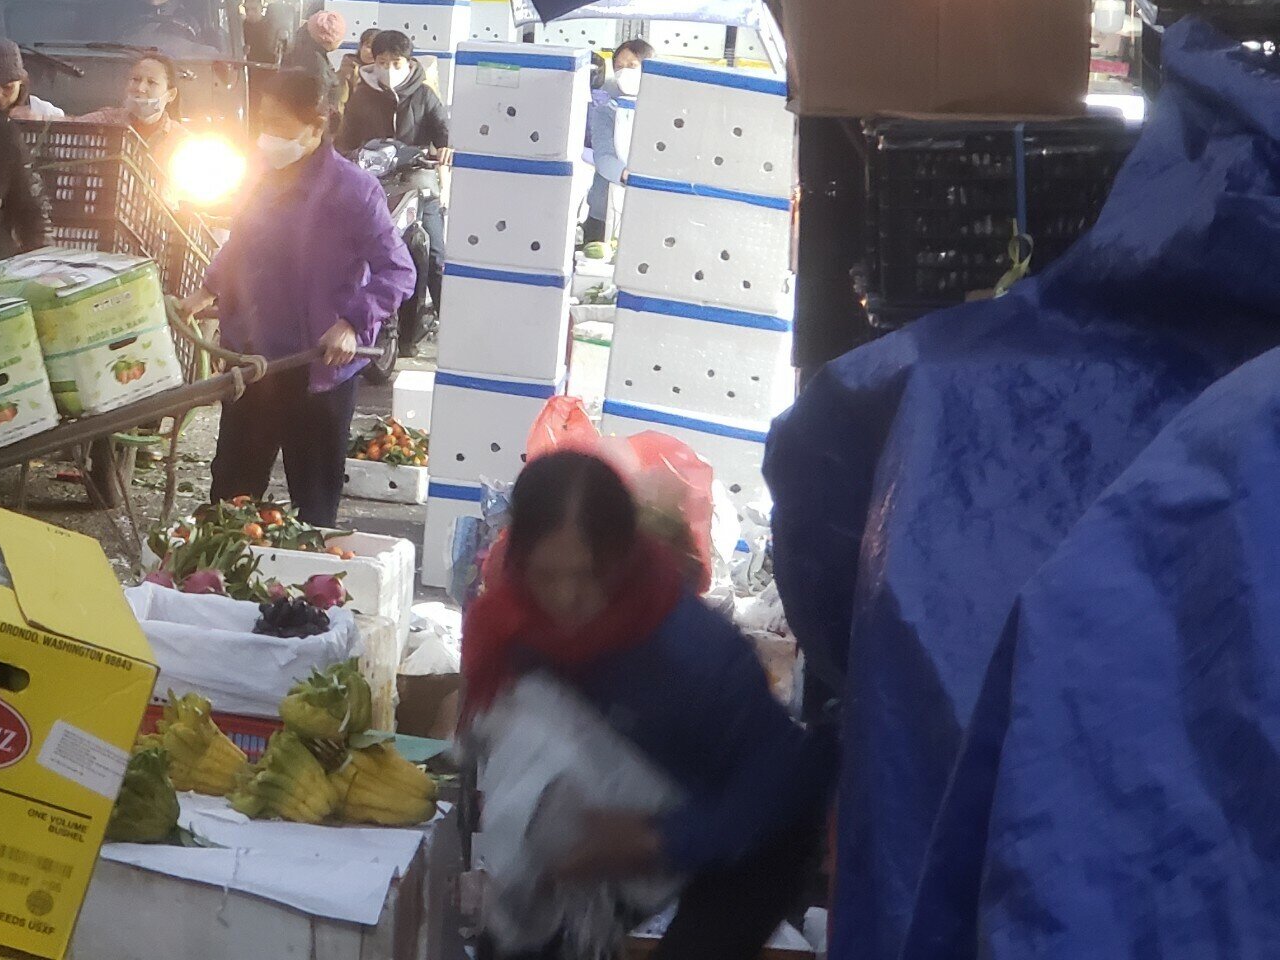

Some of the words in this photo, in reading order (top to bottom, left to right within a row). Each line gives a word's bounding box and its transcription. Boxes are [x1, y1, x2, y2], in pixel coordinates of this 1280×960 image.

[42, 635, 104, 663] WASHINGTON
[27, 808, 49, 821] ONE
[50, 815, 88, 833] VOLUME
[48, 824, 85, 843] BUSHEL
